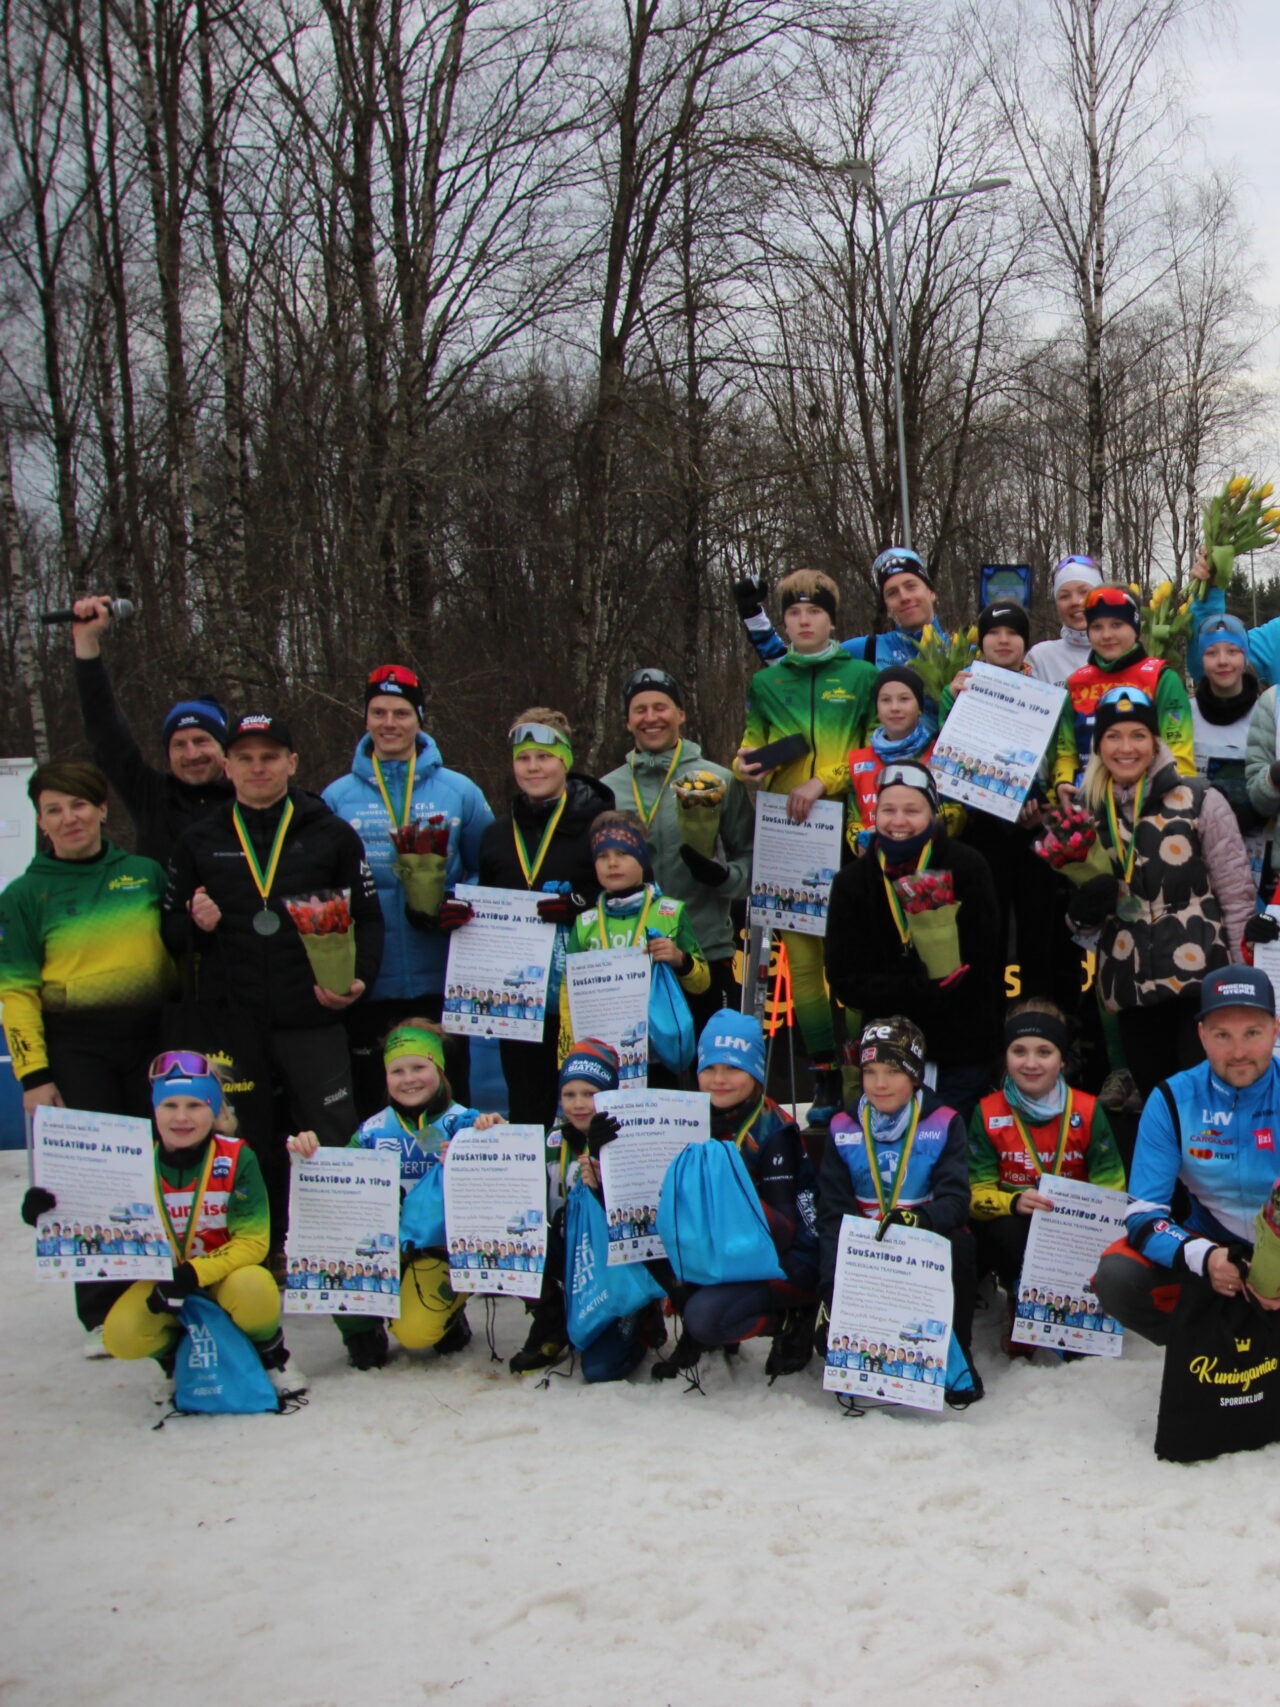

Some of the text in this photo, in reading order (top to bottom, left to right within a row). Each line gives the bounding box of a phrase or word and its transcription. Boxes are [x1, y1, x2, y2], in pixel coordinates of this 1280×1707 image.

[861, 1025, 891, 1044] ice
[714, 1035, 752, 1052] LHV
[910, 1039, 923, 1058] ice
[1202, 1109, 1233, 1126] LHV
[918, 1130, 942, 1141] BMW
[1214, 1150, 1235, 1160] RENT
[1189, 1355, 1279, 1391] Kuningamäe
[1219, 1391, 1264, 1407] SPORDIKLUBI
